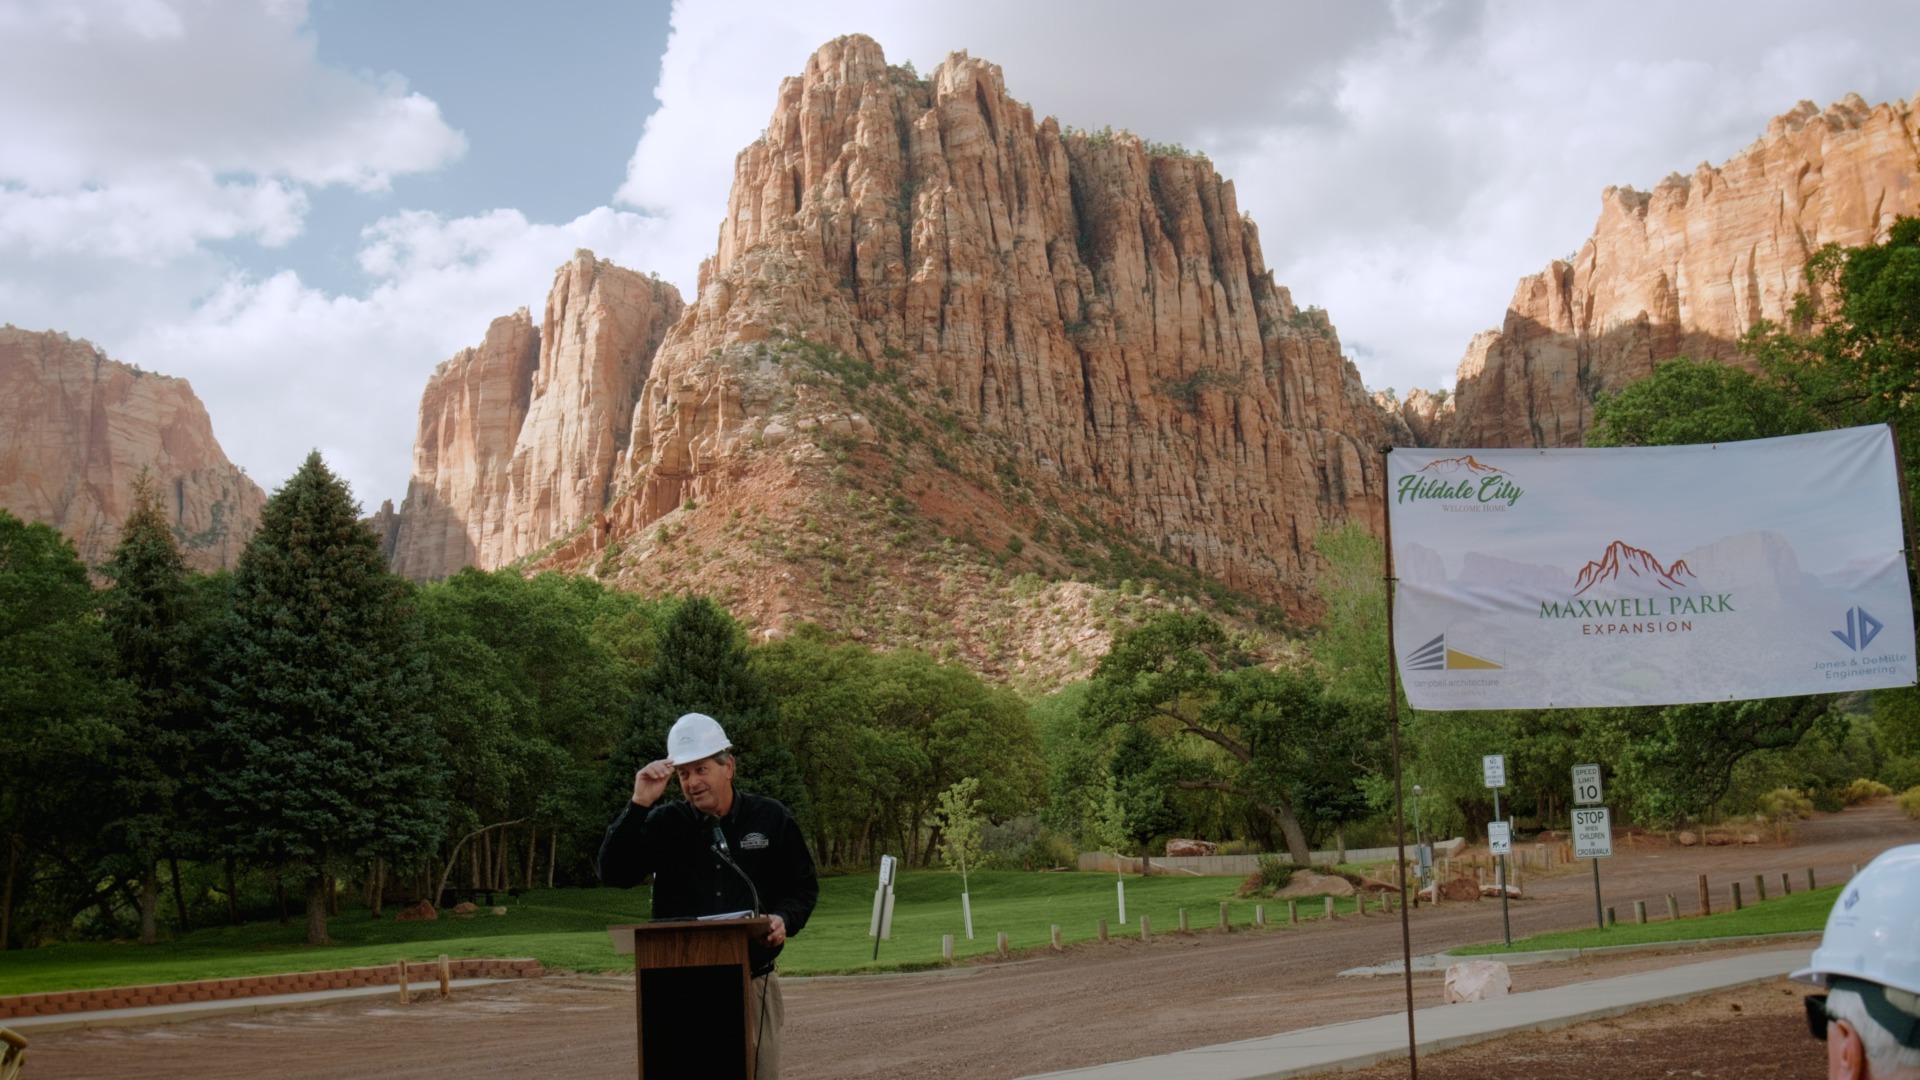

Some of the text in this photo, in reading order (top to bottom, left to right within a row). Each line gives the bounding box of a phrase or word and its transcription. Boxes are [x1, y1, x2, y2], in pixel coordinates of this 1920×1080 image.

[1397, 474, 1524, 507] Hildale City
[1539, 593, 1736, 619] MAXWELL PARK
[1582, 621, 1693, 635] EXPANSION
[1813, 653, 1907, 670] Jones & DeMille
[1825, 666, 1896, 680] Engineering
[1414, 678, 1500, 688] campbell architecture
[1575, 768, 1597, 776] SPEED
[1578, 776, 1595, 784] LIMIT
[1579, 785, 1598, 800] 10
[1576, 811, 1604, 825] STOP
[1579, 832, 1605, 840] CHILDREN
